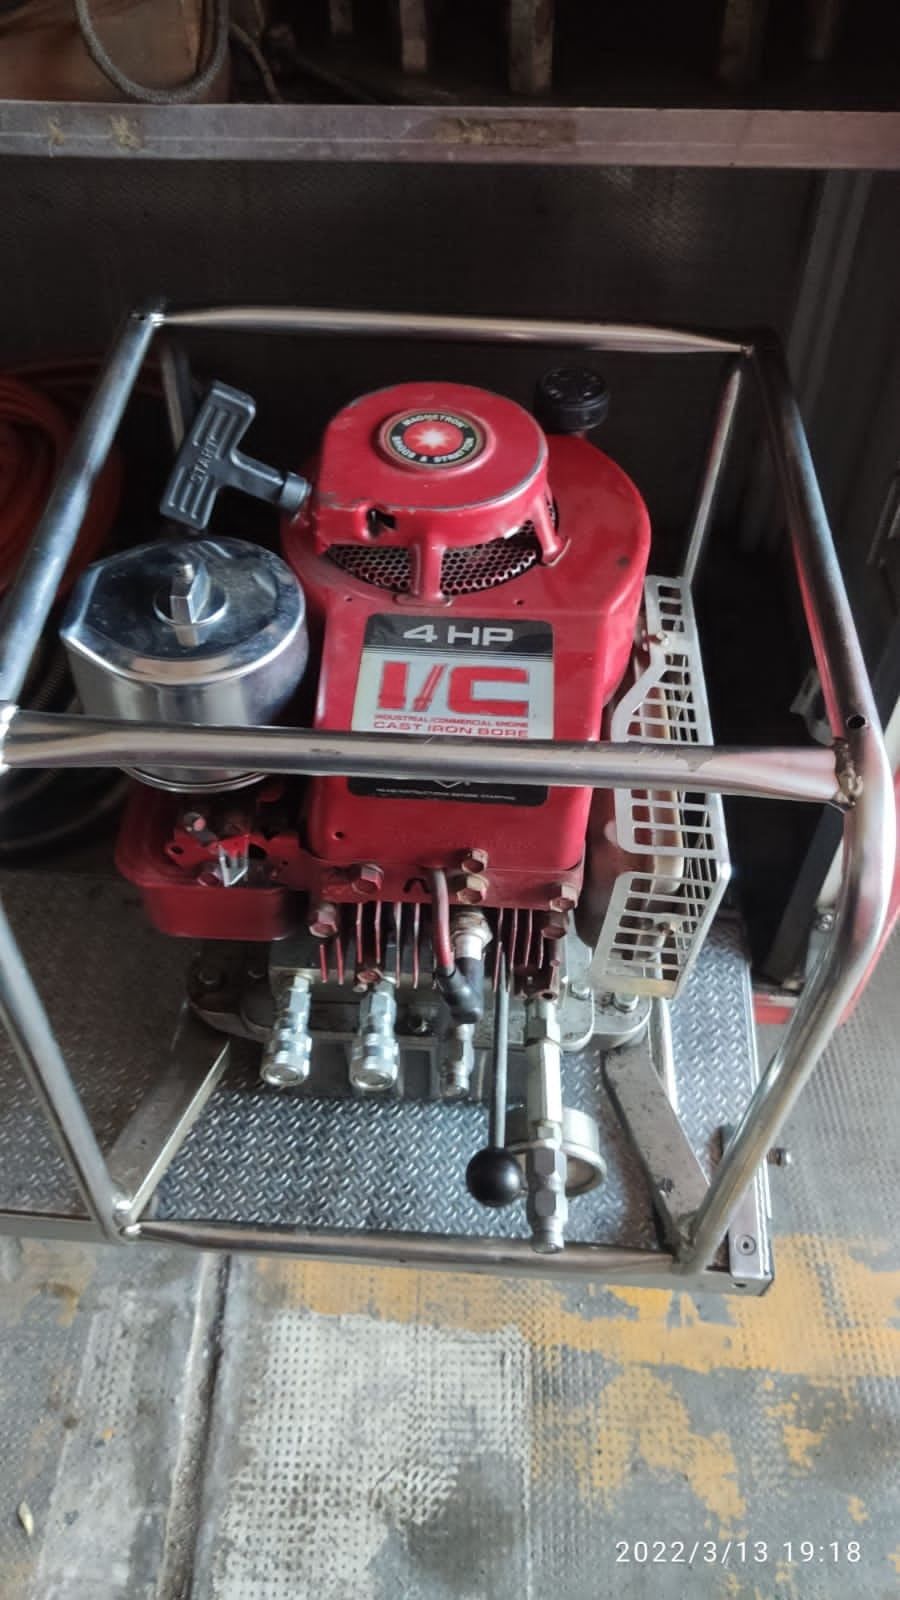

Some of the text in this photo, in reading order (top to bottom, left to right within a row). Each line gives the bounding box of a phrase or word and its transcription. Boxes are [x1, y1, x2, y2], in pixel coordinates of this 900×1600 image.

[190, 437, 217, 482] START
[403, 624, 514, 647] 4 HP
[373, 721, 529, 738] CAST IRON BORE
